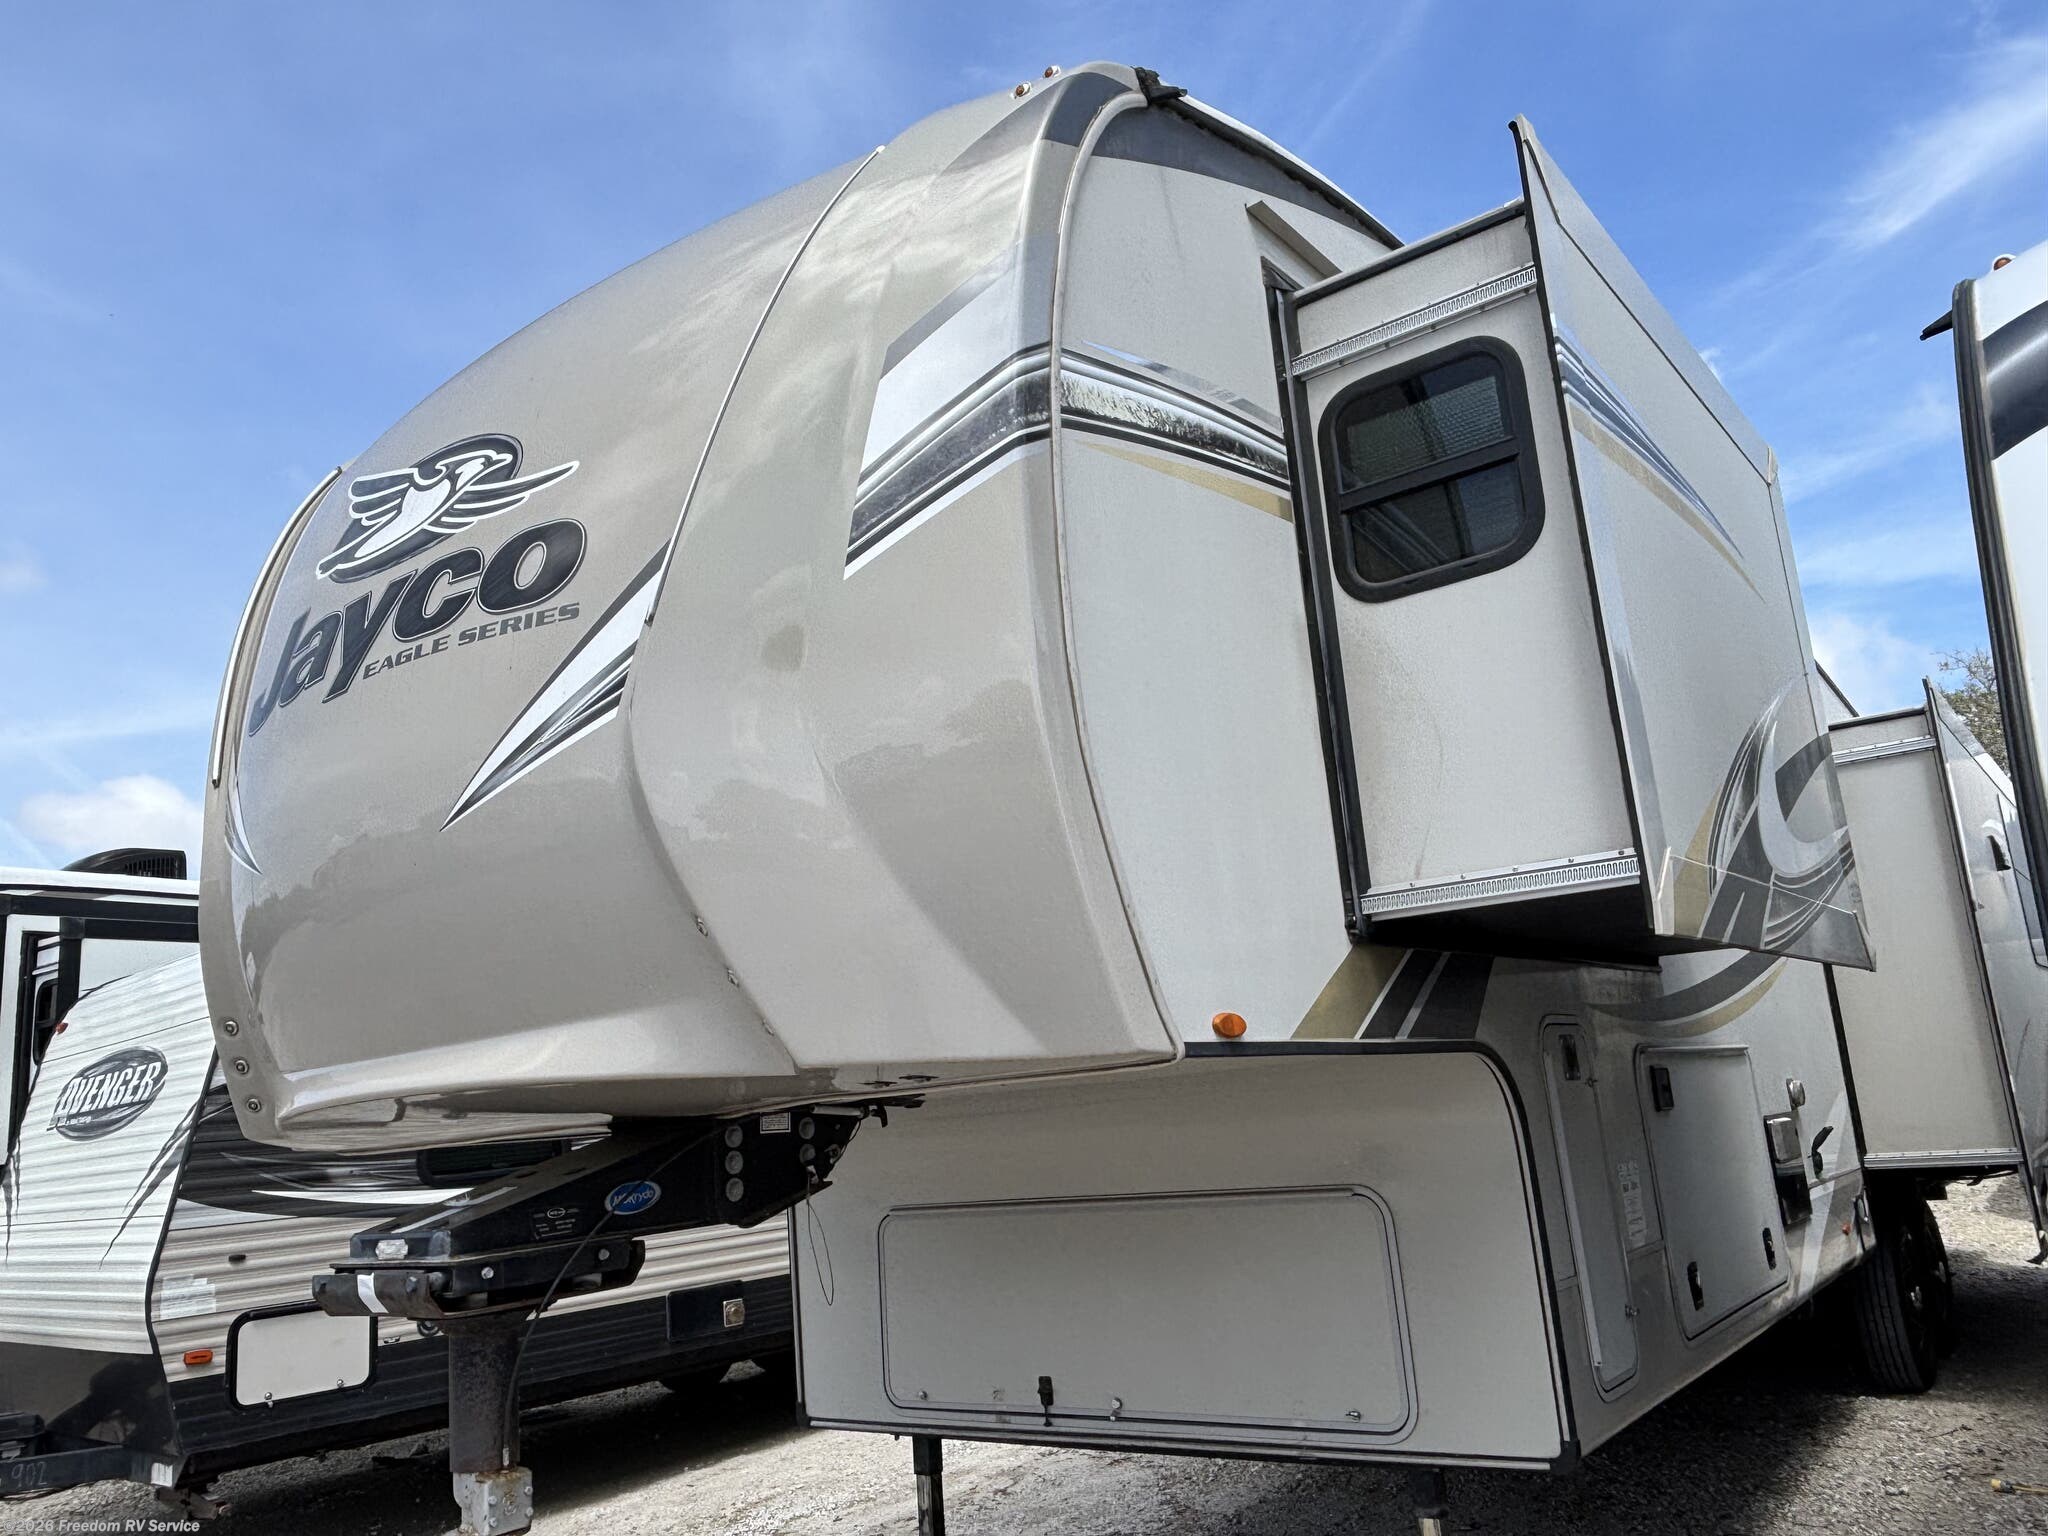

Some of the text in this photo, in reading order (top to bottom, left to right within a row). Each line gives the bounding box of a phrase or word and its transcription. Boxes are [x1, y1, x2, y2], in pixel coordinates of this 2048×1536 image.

[362, 602, 581, 680] EAGLE SERIES
[50, 1061, 162, 1122] AVENGER
